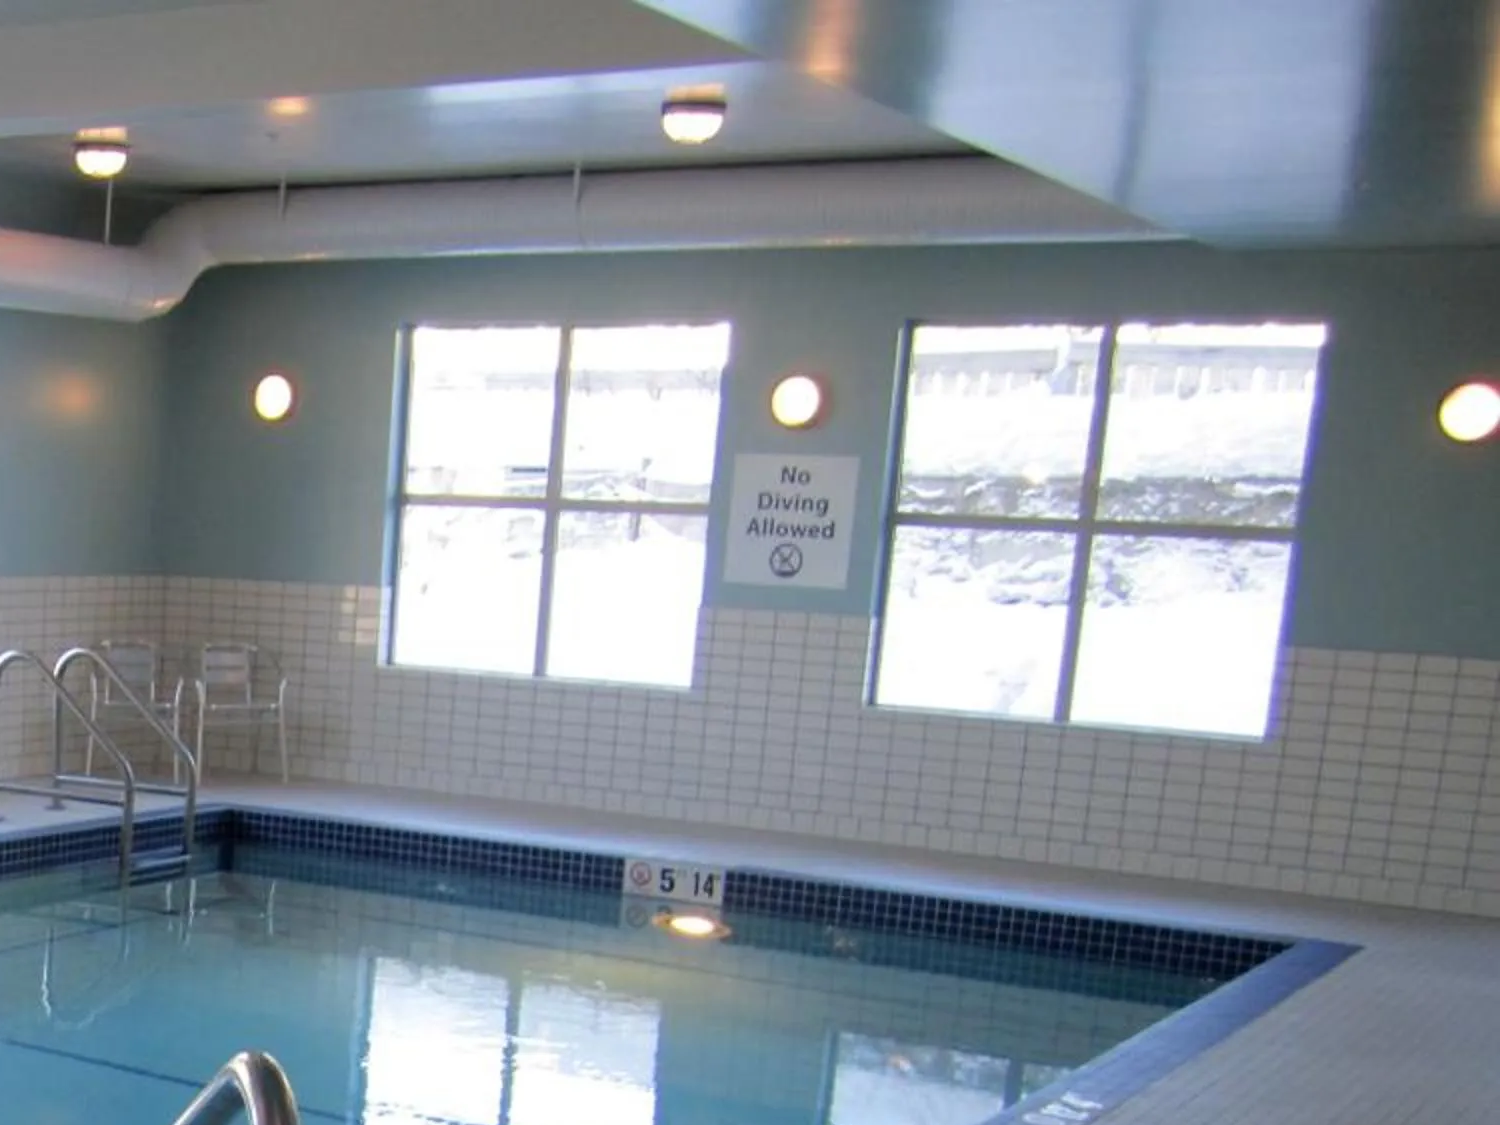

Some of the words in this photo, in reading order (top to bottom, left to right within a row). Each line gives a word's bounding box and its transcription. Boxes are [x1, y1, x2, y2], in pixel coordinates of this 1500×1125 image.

[781, 466, 811, 485] No
[758, 491, 829, 517] Diving
[747, 517, 836, 540] Allowed
[660, 868, 675, 893] 5
